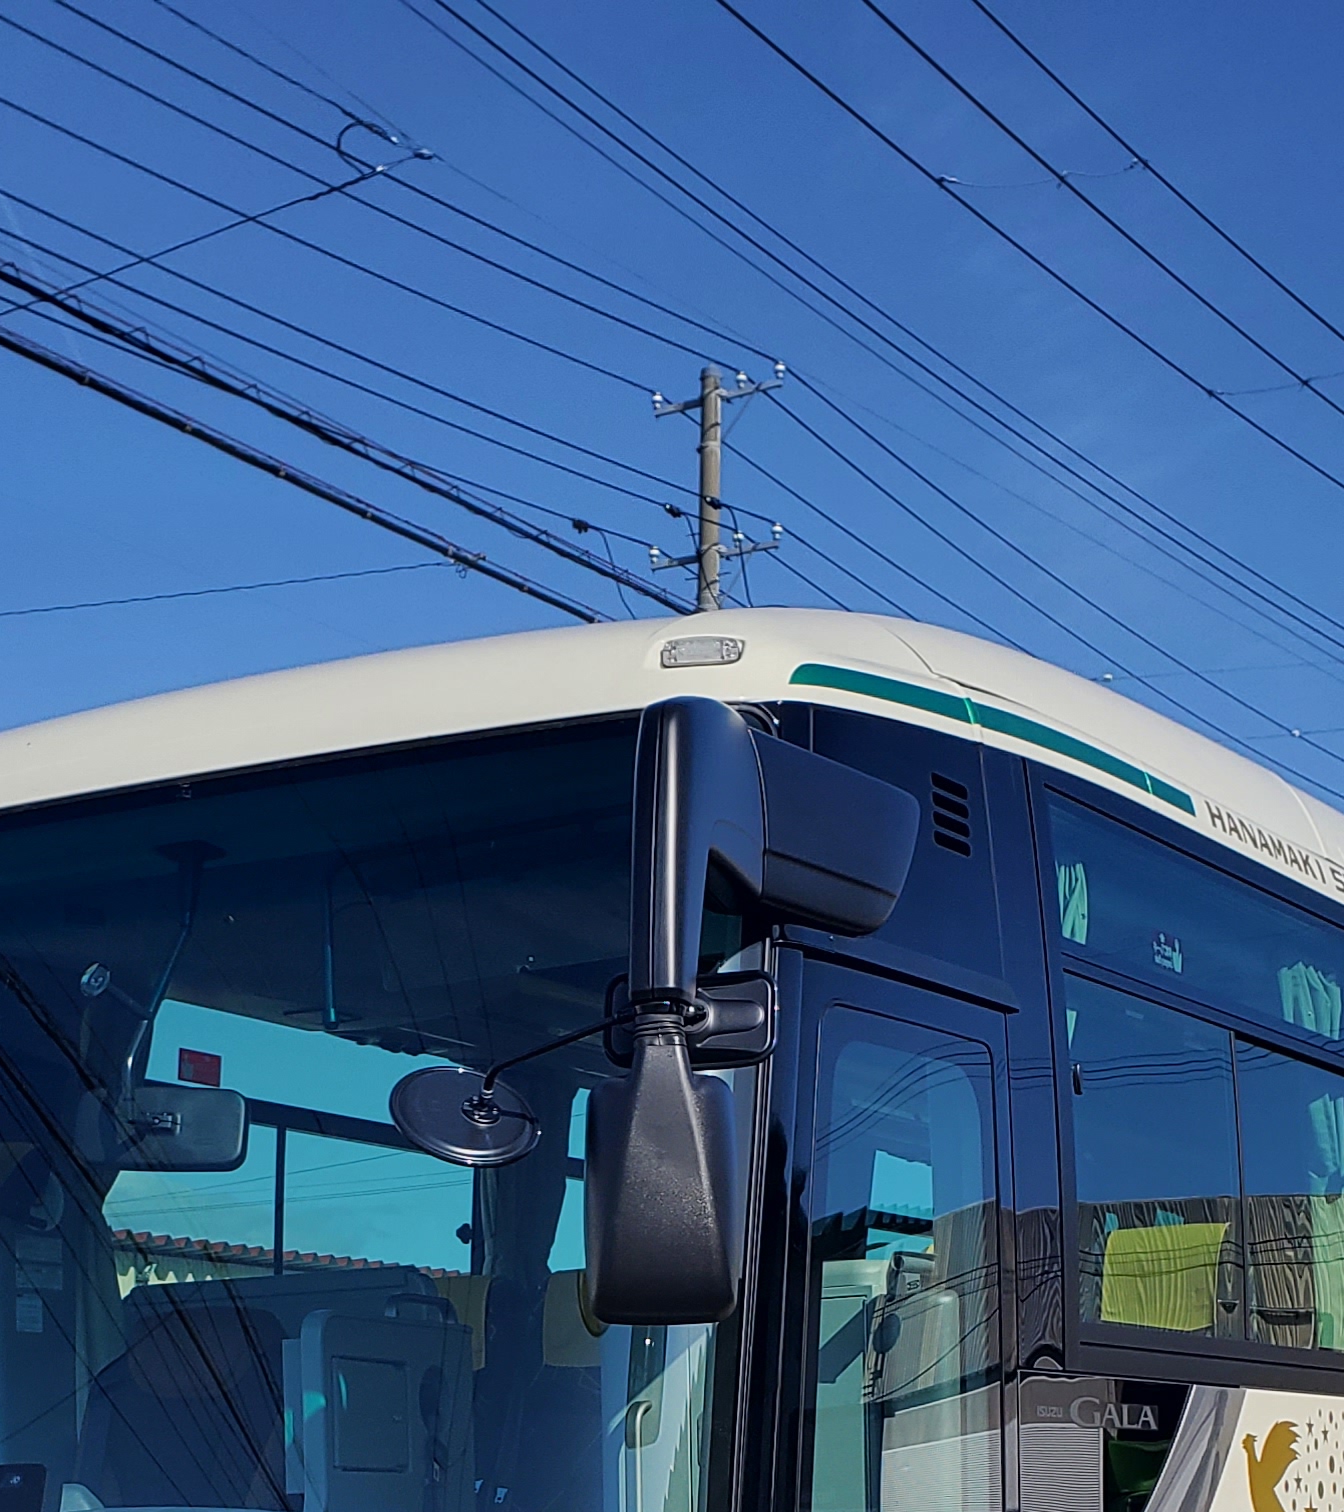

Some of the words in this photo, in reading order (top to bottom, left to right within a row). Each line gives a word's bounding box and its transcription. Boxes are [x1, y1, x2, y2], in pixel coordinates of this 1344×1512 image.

[1205, 799, 1327, 885] HANAMAKI
[1036, 1405, 1063, 1418] ISUZU
[1069, 1396, 1159, 1431] GALA
